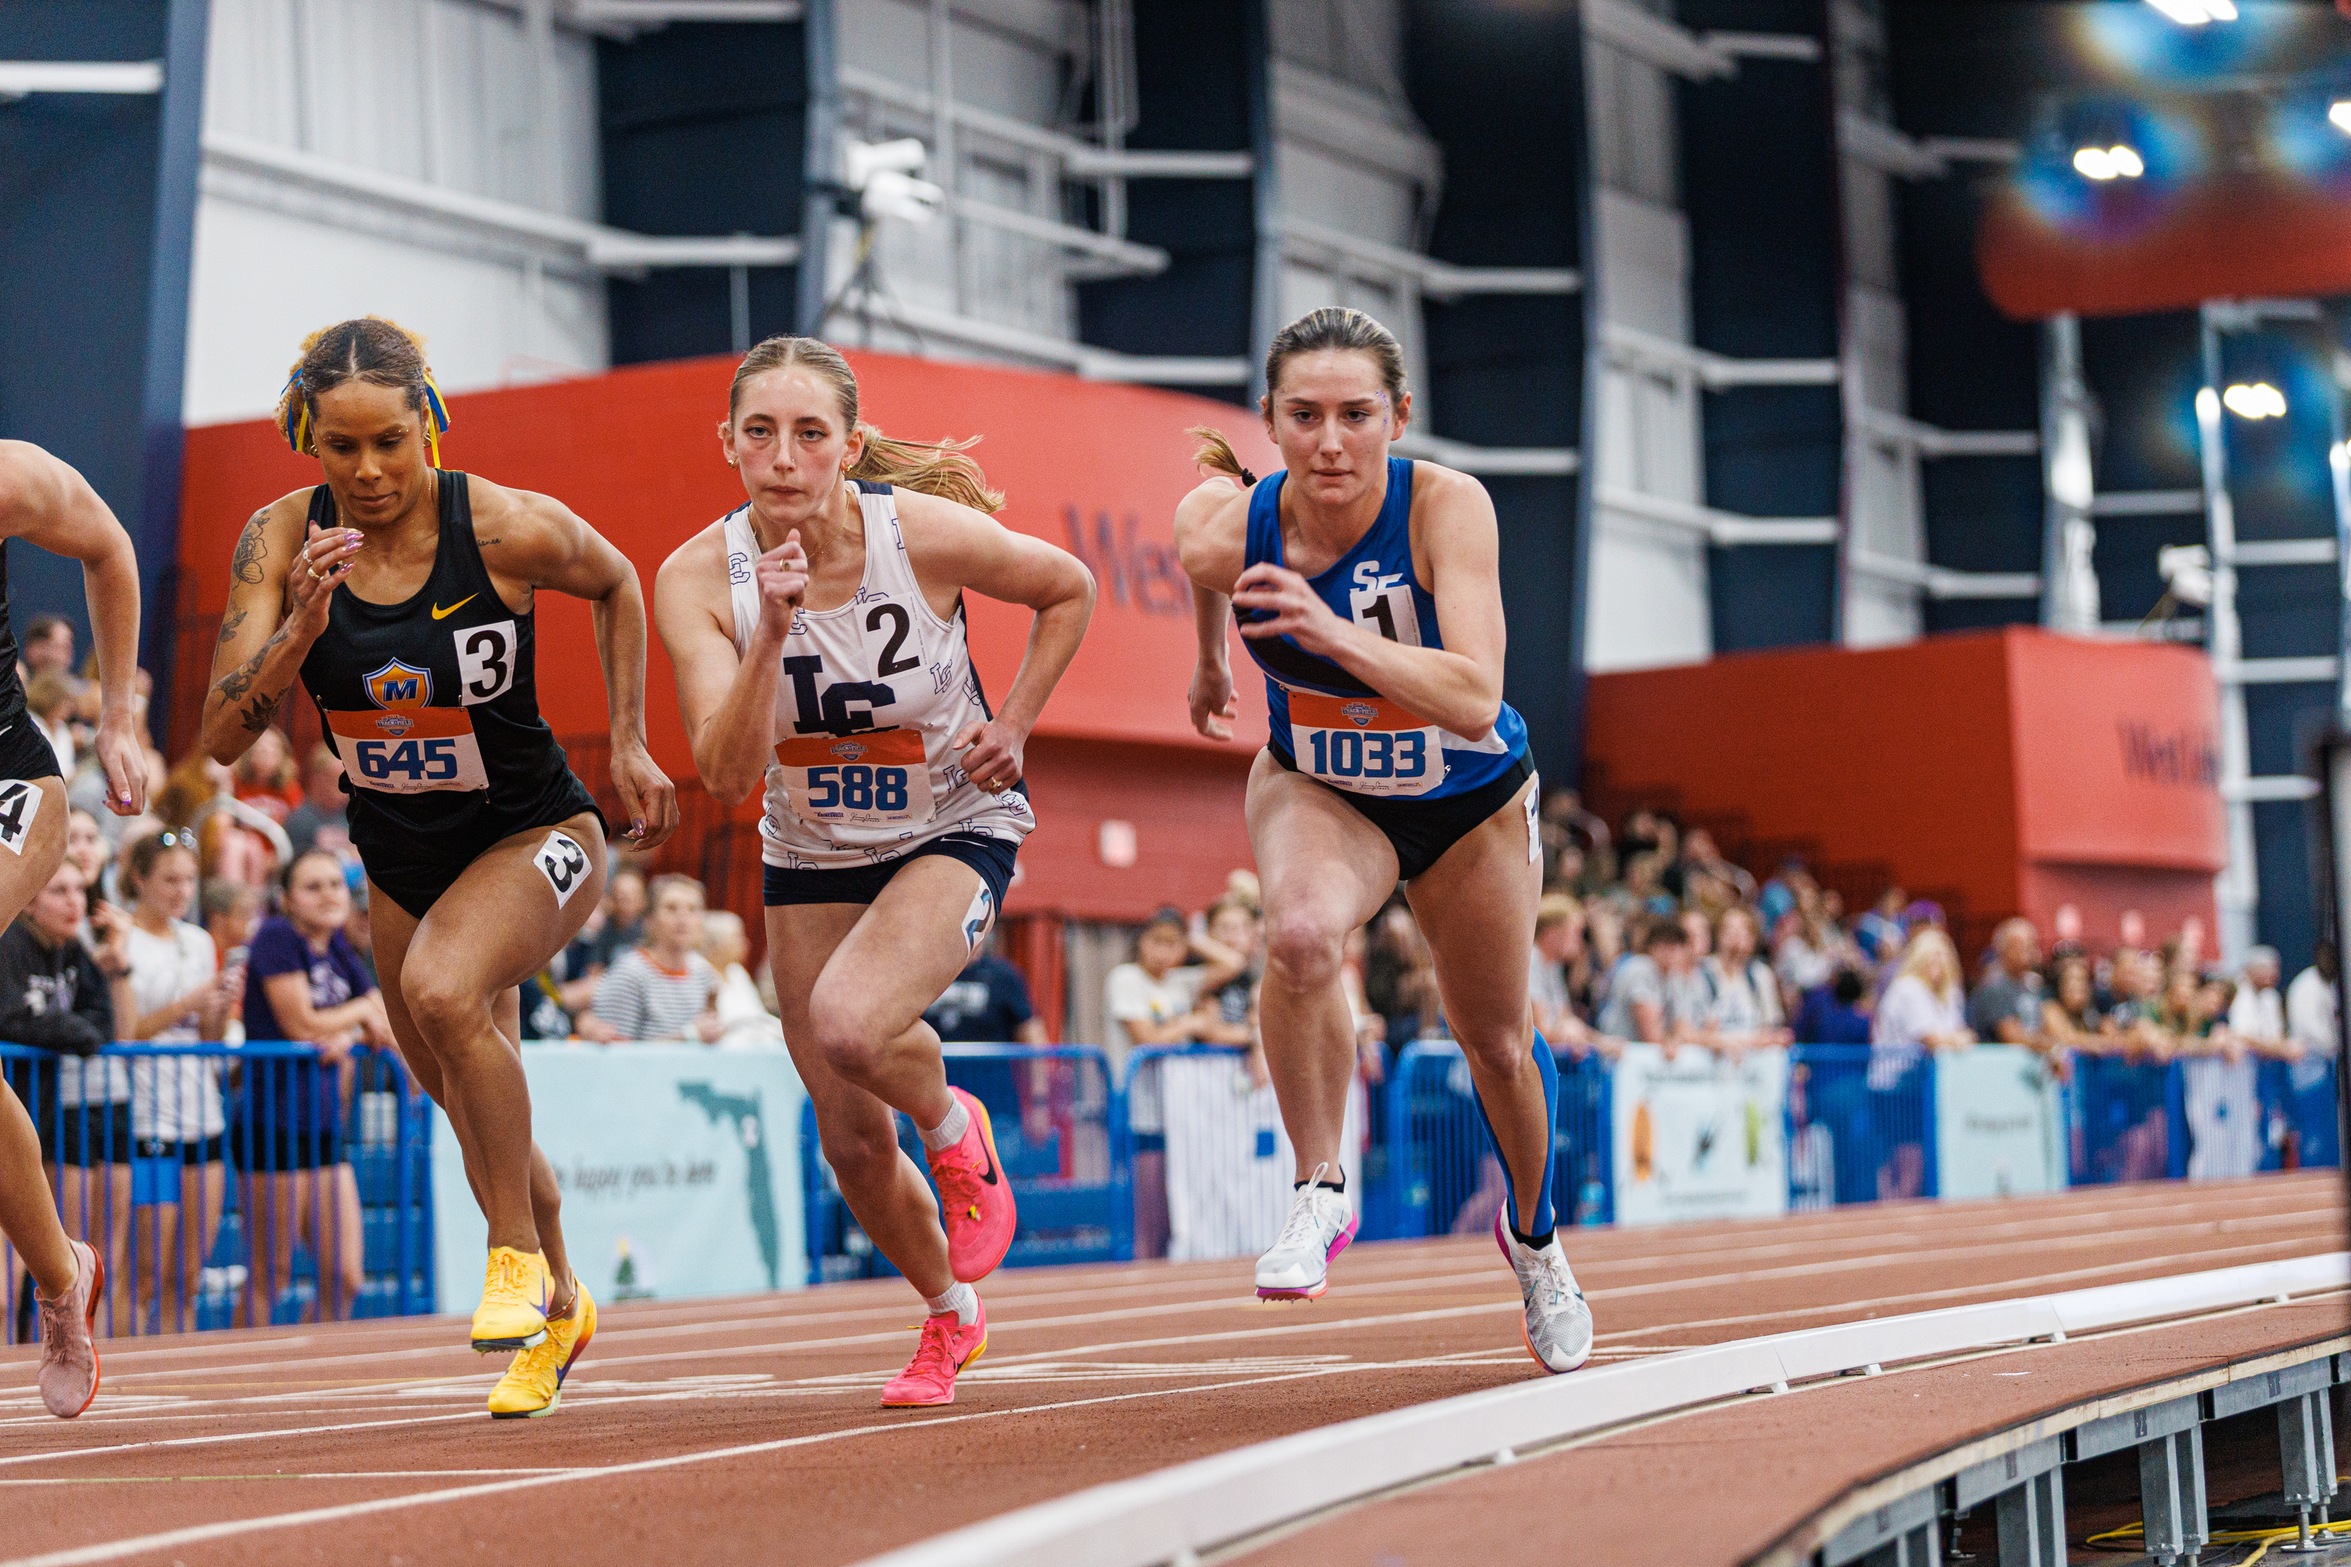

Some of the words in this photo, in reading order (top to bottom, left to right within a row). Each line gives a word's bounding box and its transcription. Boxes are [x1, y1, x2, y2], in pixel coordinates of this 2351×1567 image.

[466, 629, 508, 698] 3
[866, 603, 921, 678] 2
[382, 678, 420, 701] M
[356, 738, 458, 780] 645
[1310, 730, 1426, 778] 1033
[0, 783, 29, 843] 4
[807, 765, 908, 811] 588
[545, 838, 584, 893] 3
